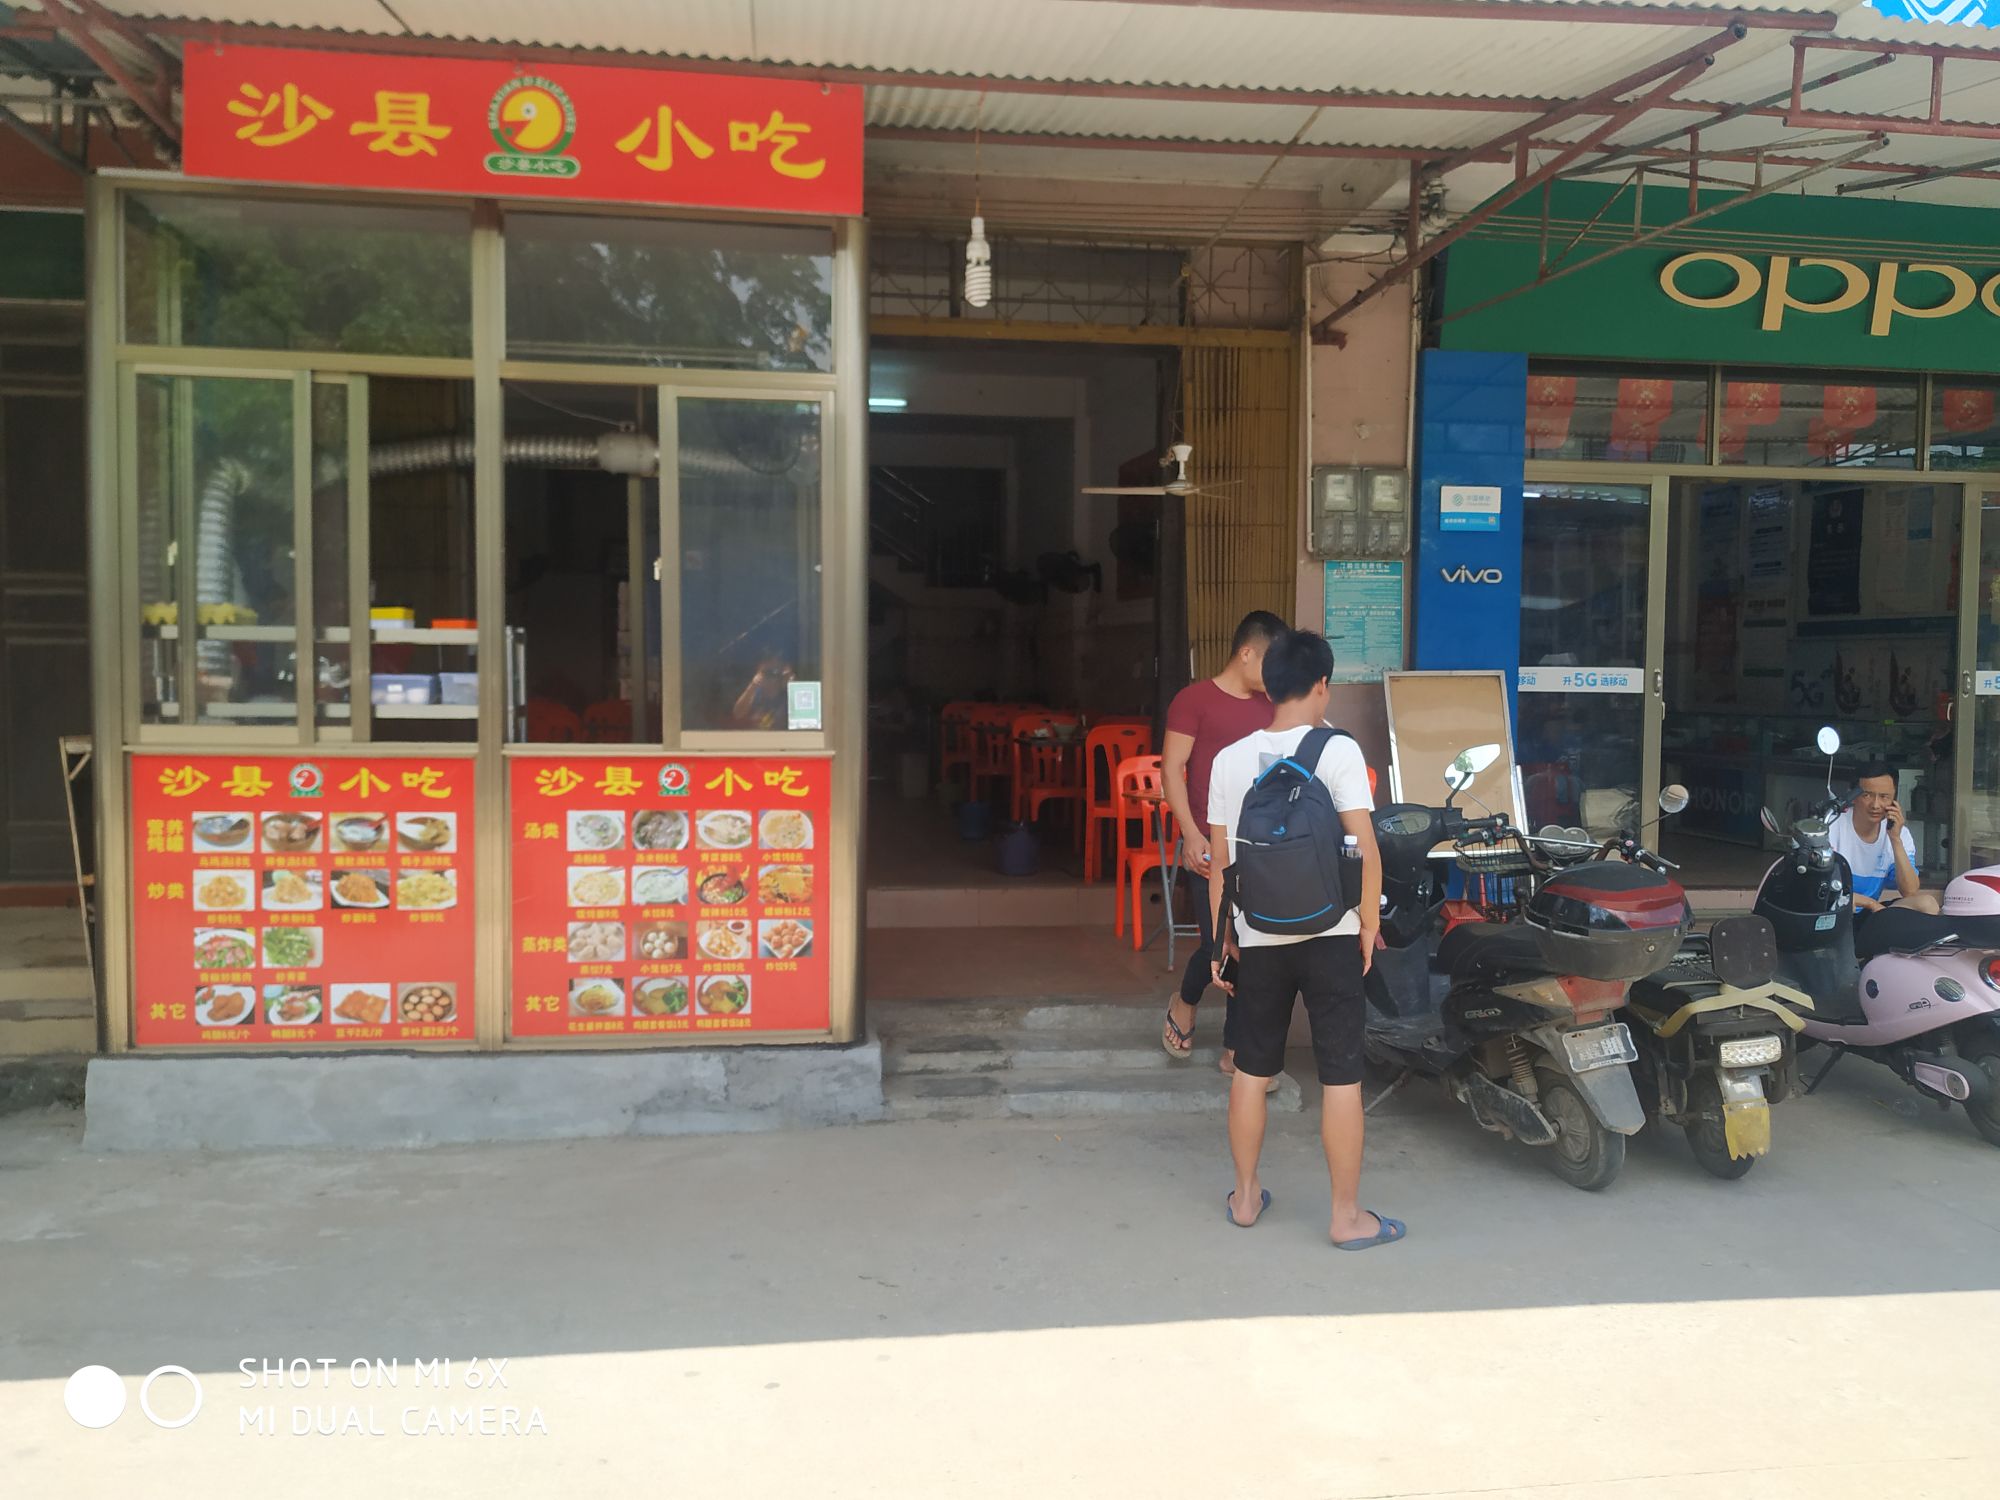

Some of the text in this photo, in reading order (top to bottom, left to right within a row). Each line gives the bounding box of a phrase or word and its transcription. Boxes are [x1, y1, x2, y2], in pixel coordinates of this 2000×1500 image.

[1441, 564, 1502, 583] vivo
[523, 822, 560, 839] 汤类
[147, 882, 184, 899] 炒类
[150, 1003, 186, 1020] 其它
[524, 995, 560, 1012] 其它
